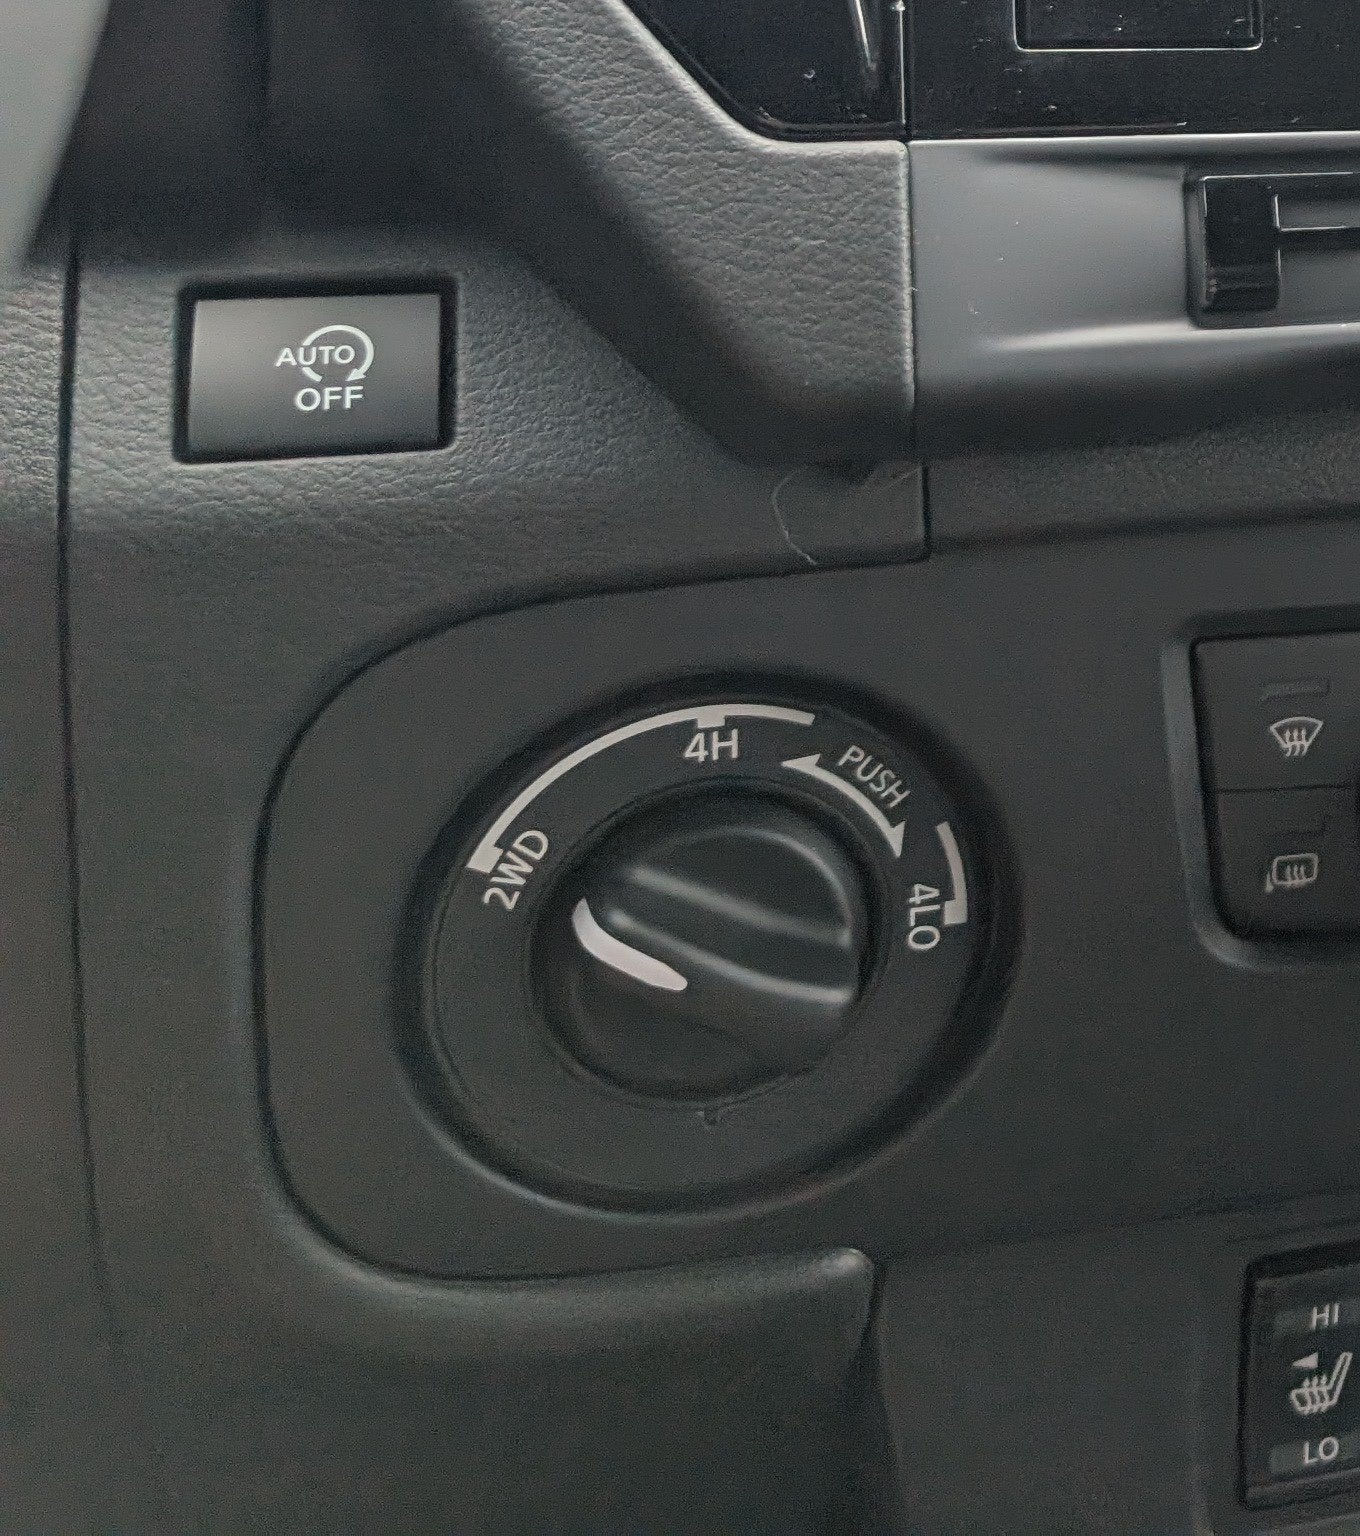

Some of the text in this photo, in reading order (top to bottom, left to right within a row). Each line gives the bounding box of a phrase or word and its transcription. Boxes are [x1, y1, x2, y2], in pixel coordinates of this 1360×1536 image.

[274, 344, 356, 368] AUTO
[294, 385, 364, 412] OFF
[684, 729, 738, 762] 4H
[836, 744, 911, 810] PUSH
[483, 828, 550, 910] 2WD
[906, 881, 941, 951] 4LO
[1309, 1303, 1341, 1331] HI
[1302, 1435, 1341, 1464] LO
